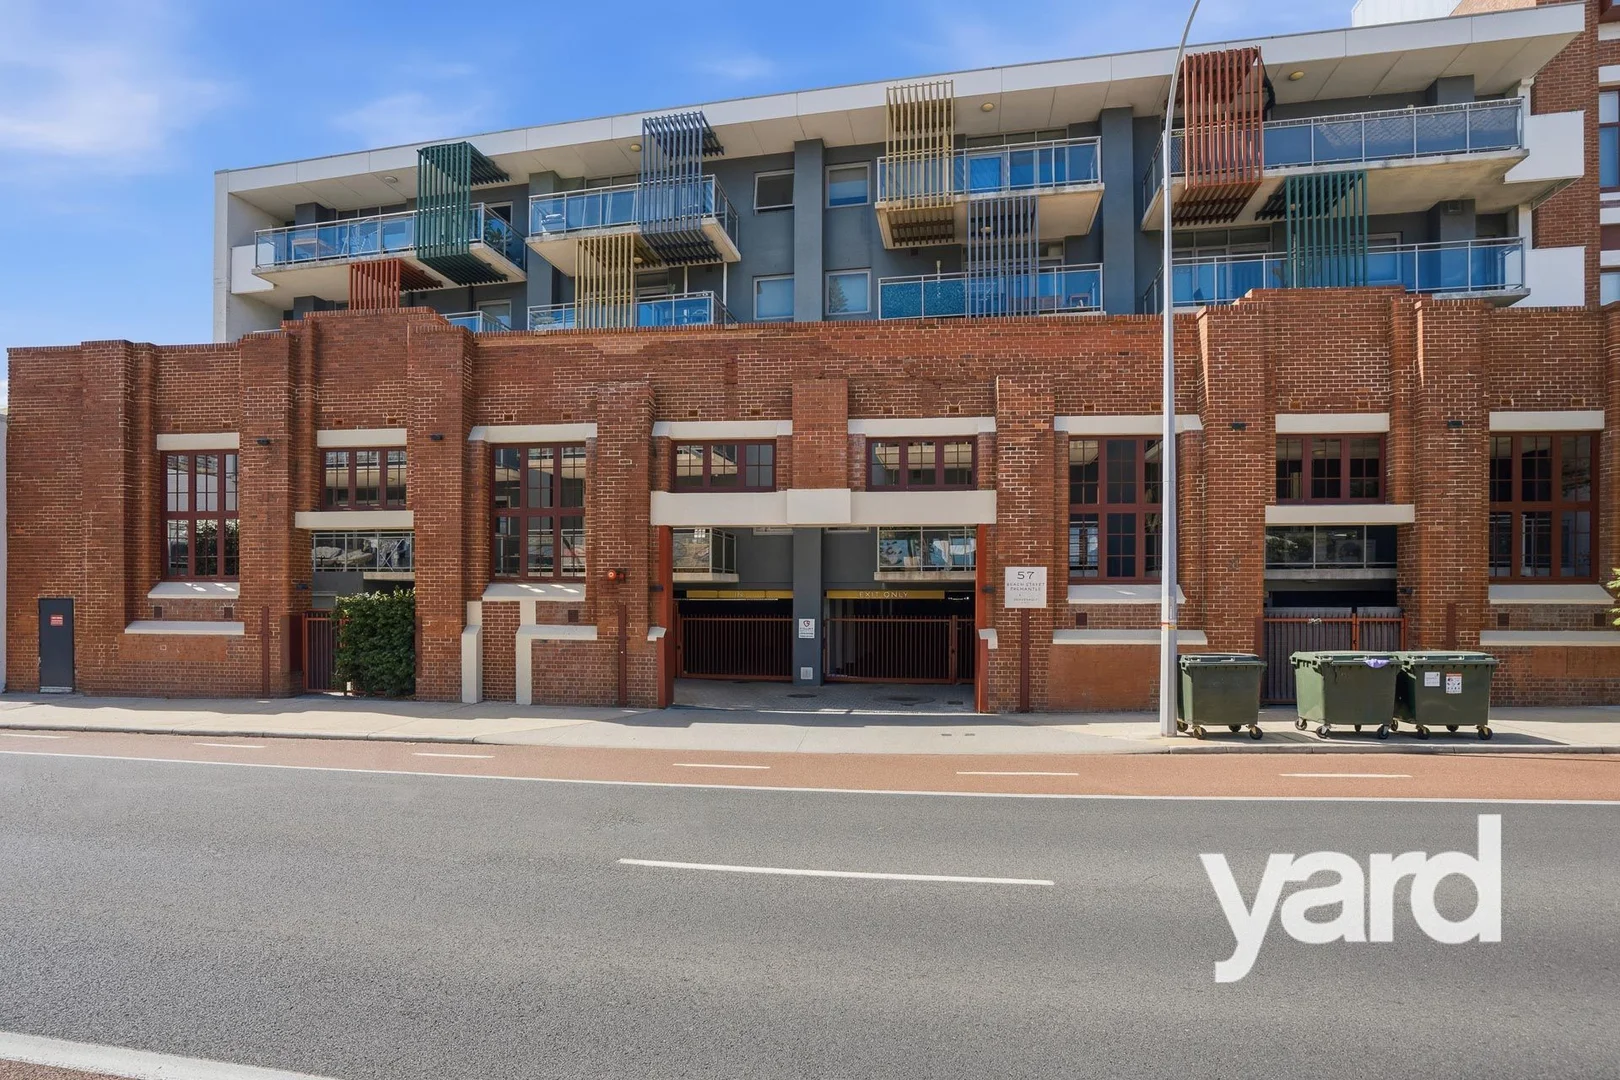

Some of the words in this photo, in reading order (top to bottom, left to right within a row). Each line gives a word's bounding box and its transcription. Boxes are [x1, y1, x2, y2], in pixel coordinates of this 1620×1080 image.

[1017, 571, 1035, 580] 57
[859, 591, 879, 599] EXIT
[883, 591, 909, 599] ONLY
